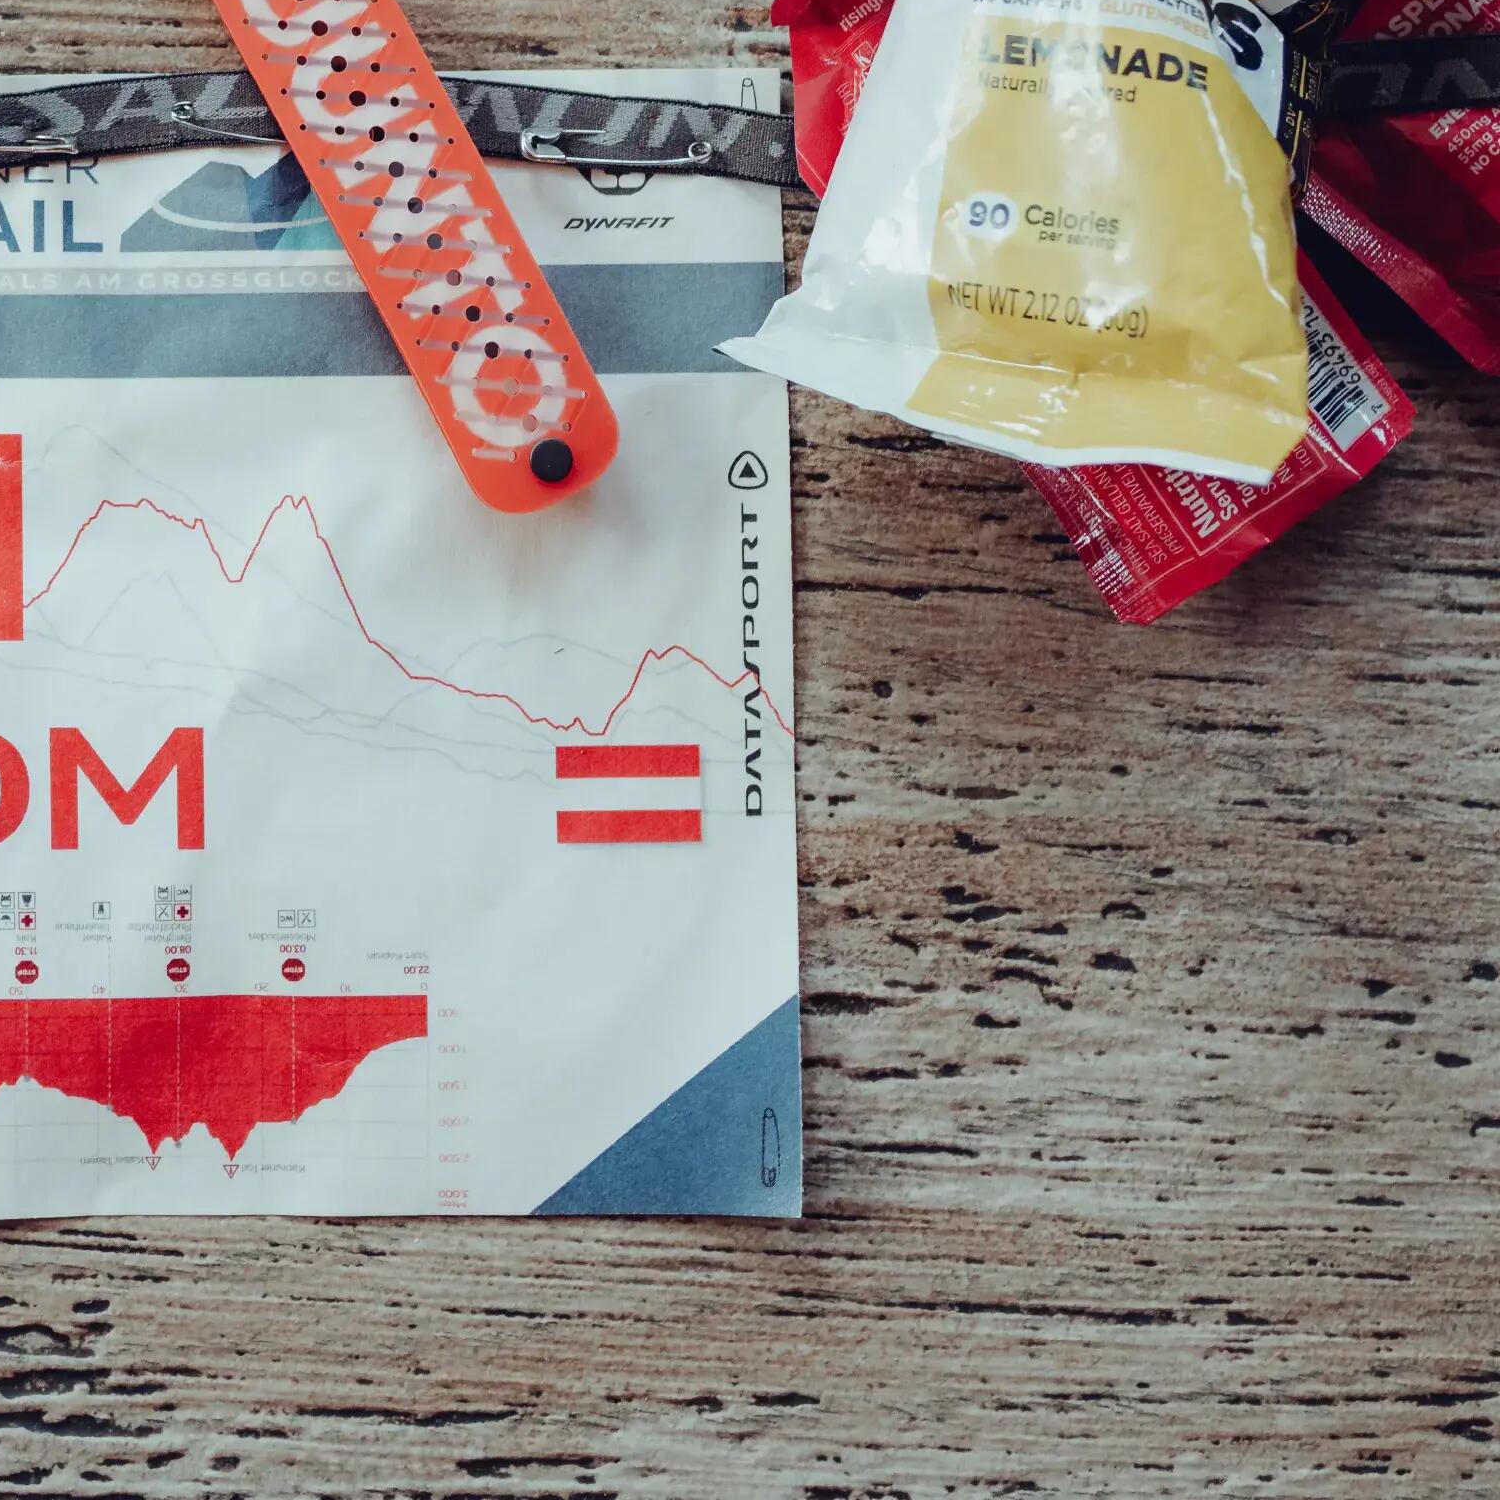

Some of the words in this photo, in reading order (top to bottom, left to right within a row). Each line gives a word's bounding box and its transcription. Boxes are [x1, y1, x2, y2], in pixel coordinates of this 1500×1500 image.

[564, 215, 676, 231] DYNAFIT
[969, 200, 1010, 230] 90
[1025, 203, 1120, 235] Calories
[1038, 229, 1062, 243] per
[1067, 233, 1117, 250] serving
[68, 271, 123, 292] AM
[137, 270, 366, 291] GROSSGLOCK
[947, 281, 982, 311] NET
[988, 284, 1020, 317] WT
[1022, 290, 1061, 323] 2.12
[1317, 330, 1361, 388] 69493
[1146, 537, 1169, 565] SEA
[740, 502, 763, 817] DATASPORT
[279, 943, 305, 953] 03.00
[402, 964, 429, 974] 22.00
[8, 985, 22, 995] 50
[91, 984, 105, 993] 40
[174, 982, 188, 992] 30
